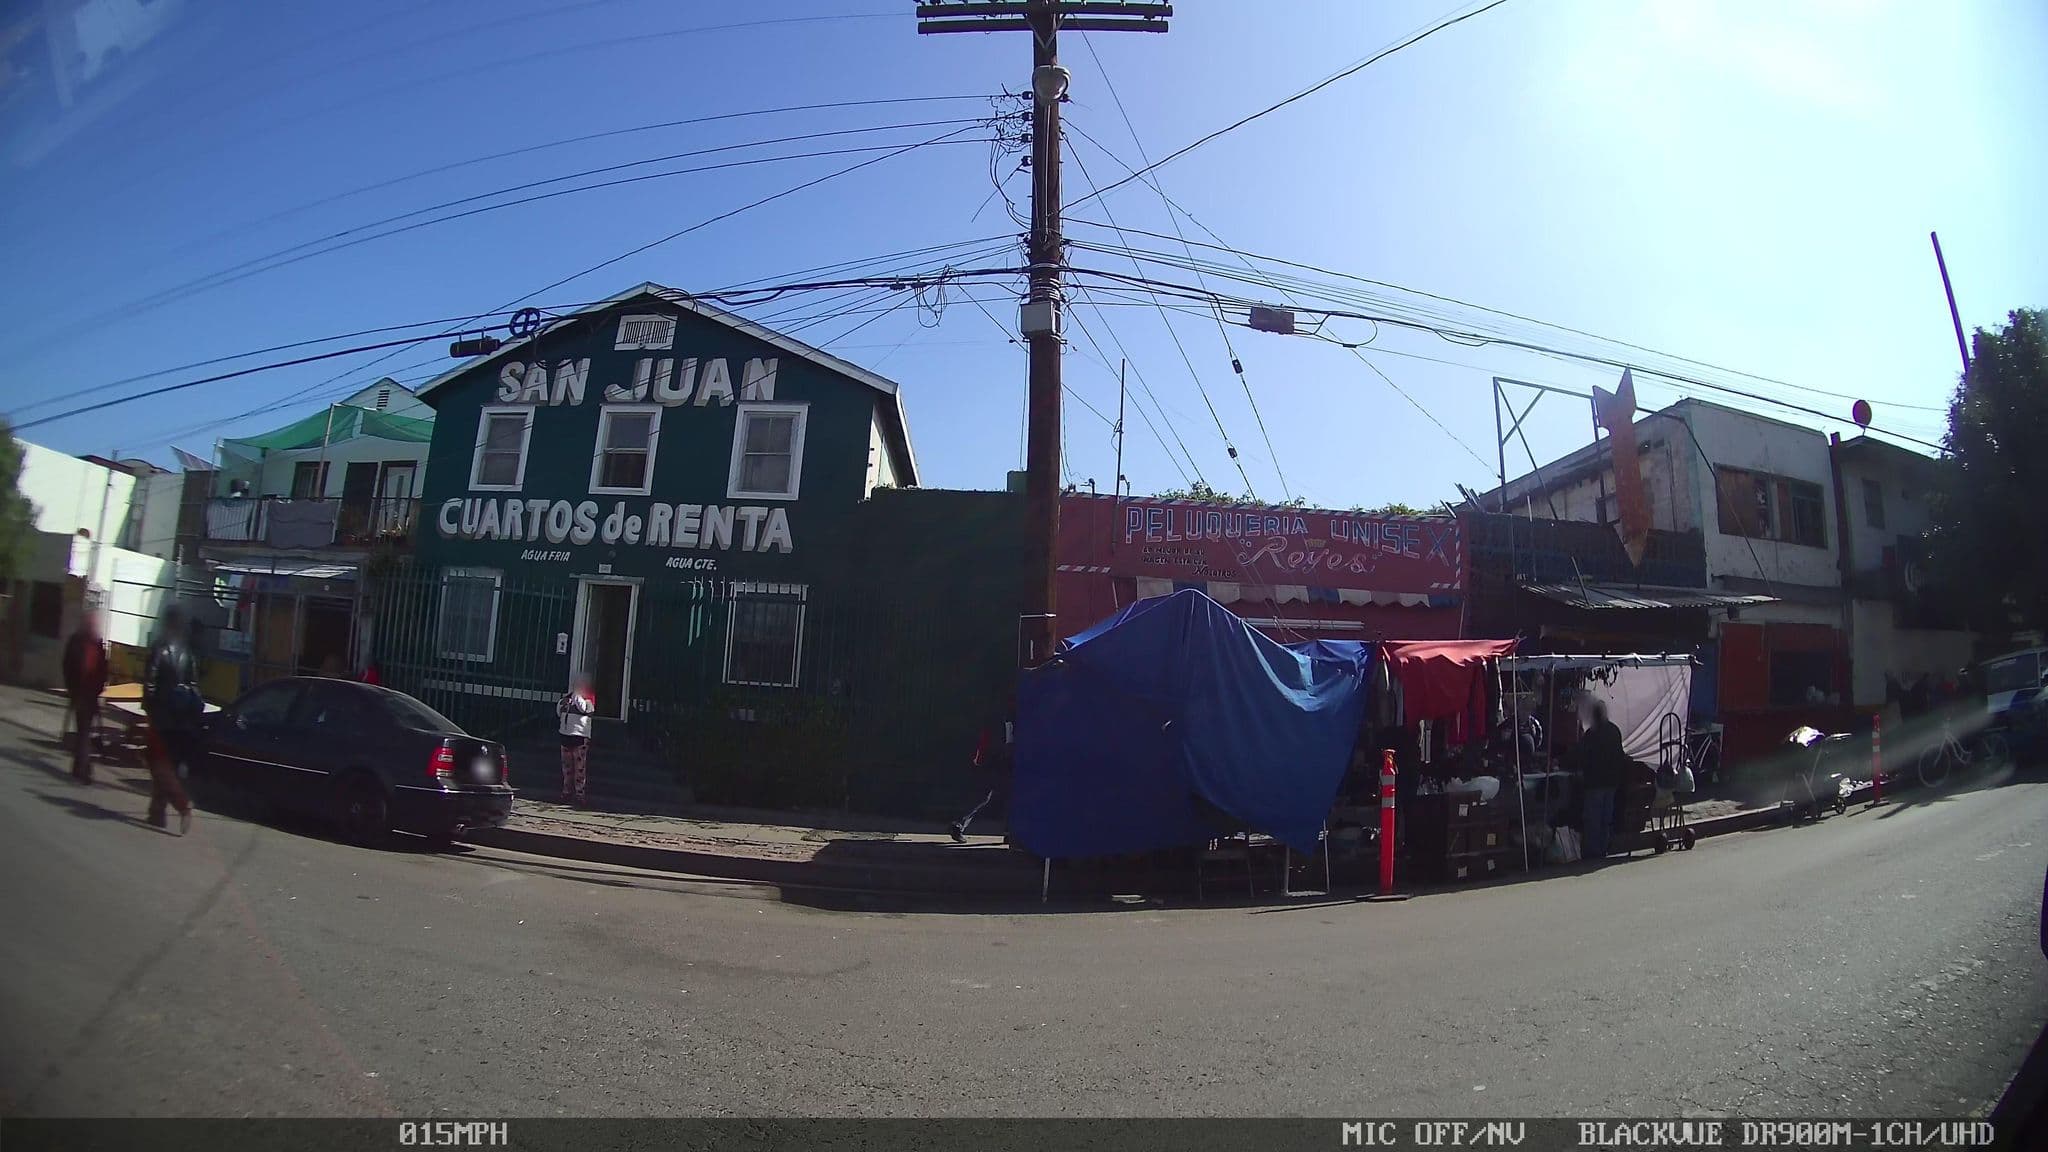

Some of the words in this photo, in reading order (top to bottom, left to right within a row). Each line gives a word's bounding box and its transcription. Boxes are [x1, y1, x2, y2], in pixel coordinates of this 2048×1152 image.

[498, 356, 591, 406] SAN
[604, 356, 778, 406] JUAN
[439, 498, 599, 546] CUARTOS
[601, 501, 642, 544] de
[644, 503, 794, 554] RENTA
[1125, 506, 1309, 544] PELUQUERIA
[1330, 519, 1453, 567] UNISEX
[521, 549, 546, 561] AGUA
[548, 551, 571, 562] FRIA
[665, 557, 693, 569] AGUA
[694, 559, 718, 571] CTE.
[1237, 535, 1376, 574] Reyes
